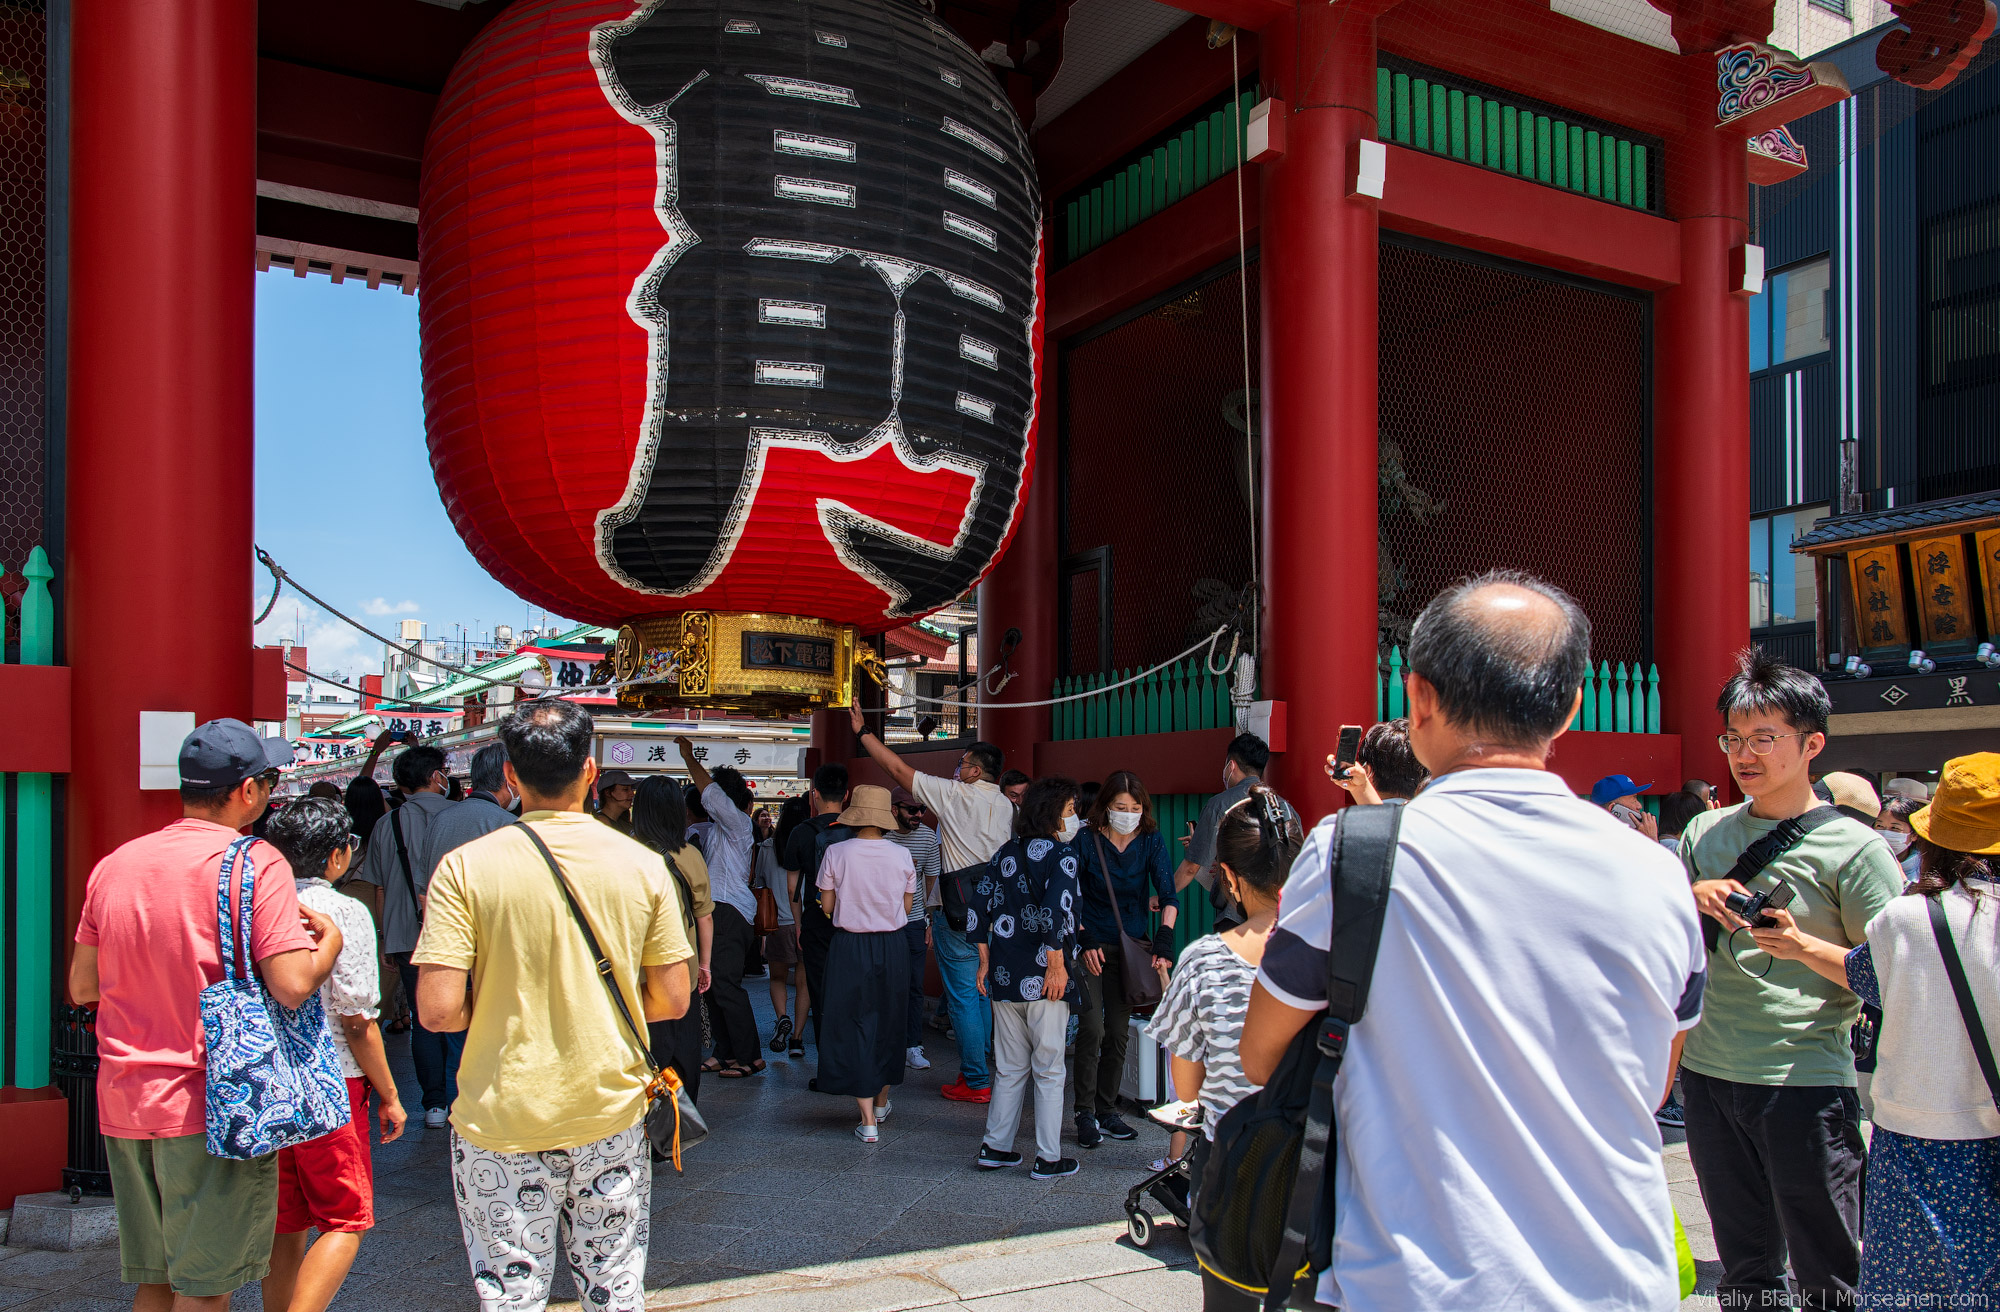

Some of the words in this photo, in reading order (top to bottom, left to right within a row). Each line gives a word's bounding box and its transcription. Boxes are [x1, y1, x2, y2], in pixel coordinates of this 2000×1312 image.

[1928, 551, 1957, 634] 浮世絵
[1865, 561, 1893, 641] 千社札
[751, 639, 831, 668] 松下電器
[647, 745, 752, 765] 浅草寺
[604, 1153, 626, 1165] Brown
[520, 1165, 541, 1176] Smile
[477, 1189, 498, 1198] Brown
[491, 1228, 513, 1239] GAP
[535, 1247, 556, 1261] Brown
